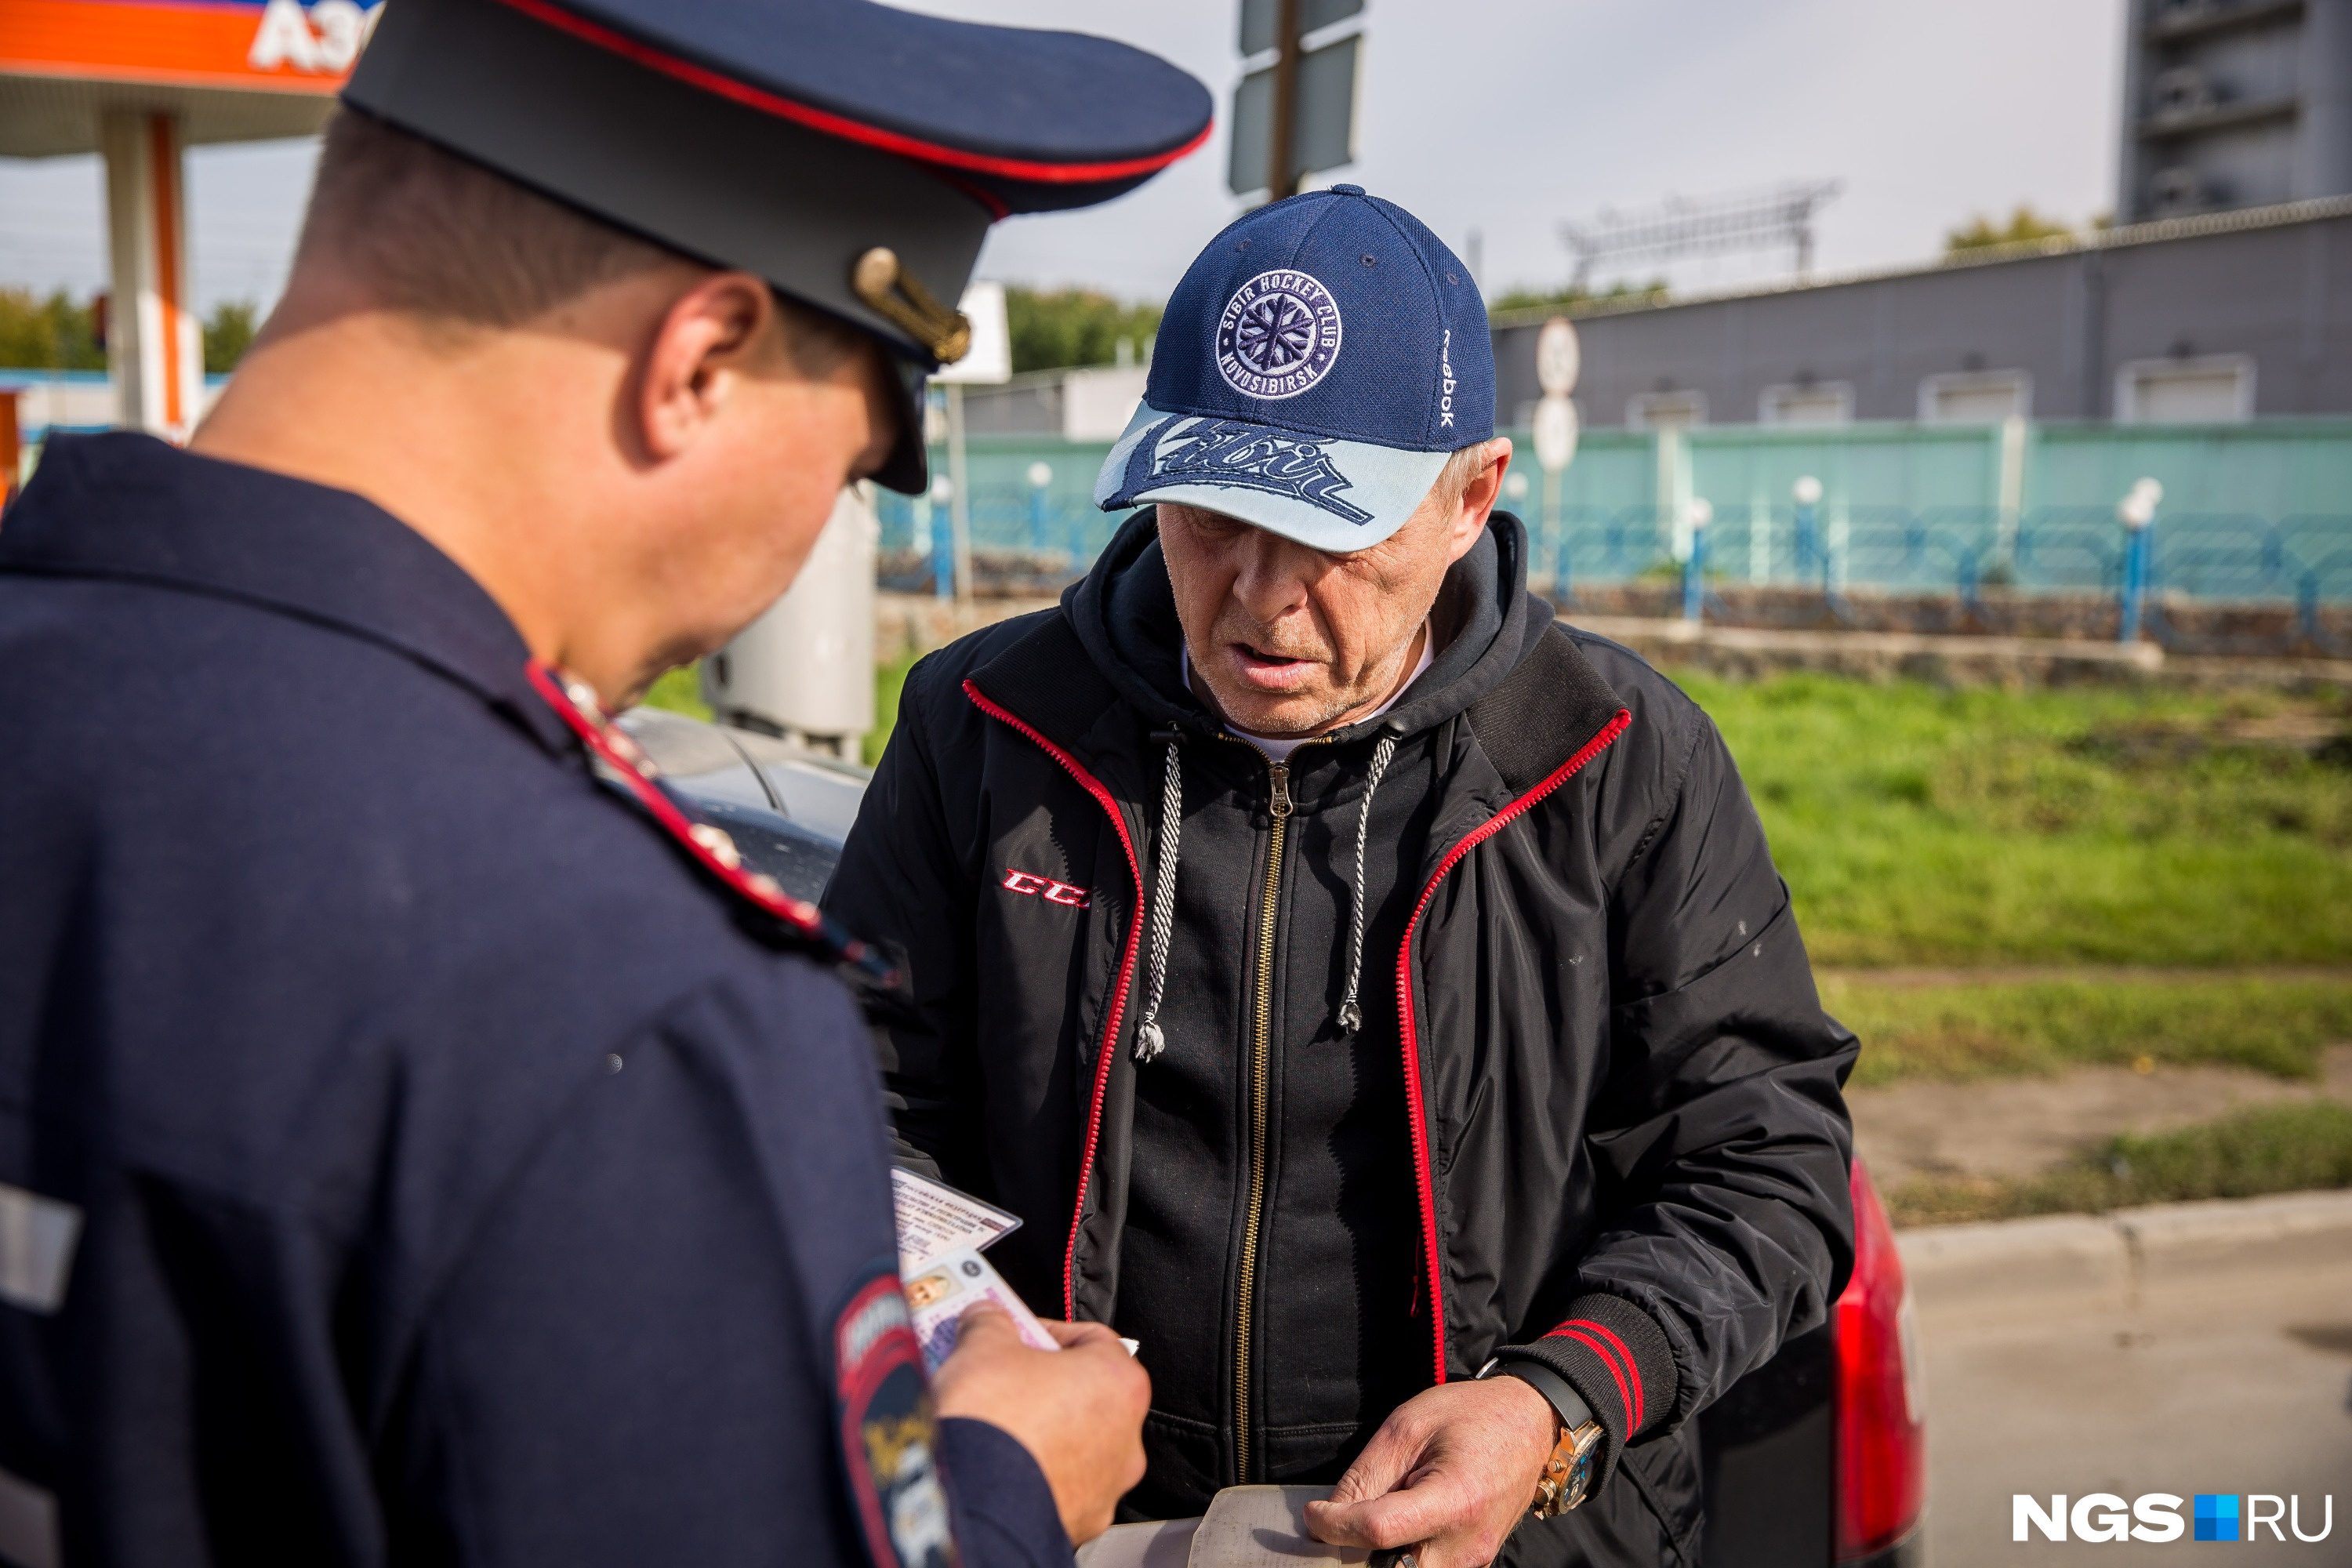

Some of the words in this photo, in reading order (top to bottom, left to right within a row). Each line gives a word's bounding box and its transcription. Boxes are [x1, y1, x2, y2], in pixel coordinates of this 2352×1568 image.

[246, 0, 388, 74] АЗ
[1222, 287, 1256, 330] SIBIR
[1260, 274, 1323, 301] HOCKEY
[1318, 305, 1337, 348] CLUB
[1220, 352, 1319, 394] NOVOSIBIRSK
[1002, 868, 1091, 909] CC
